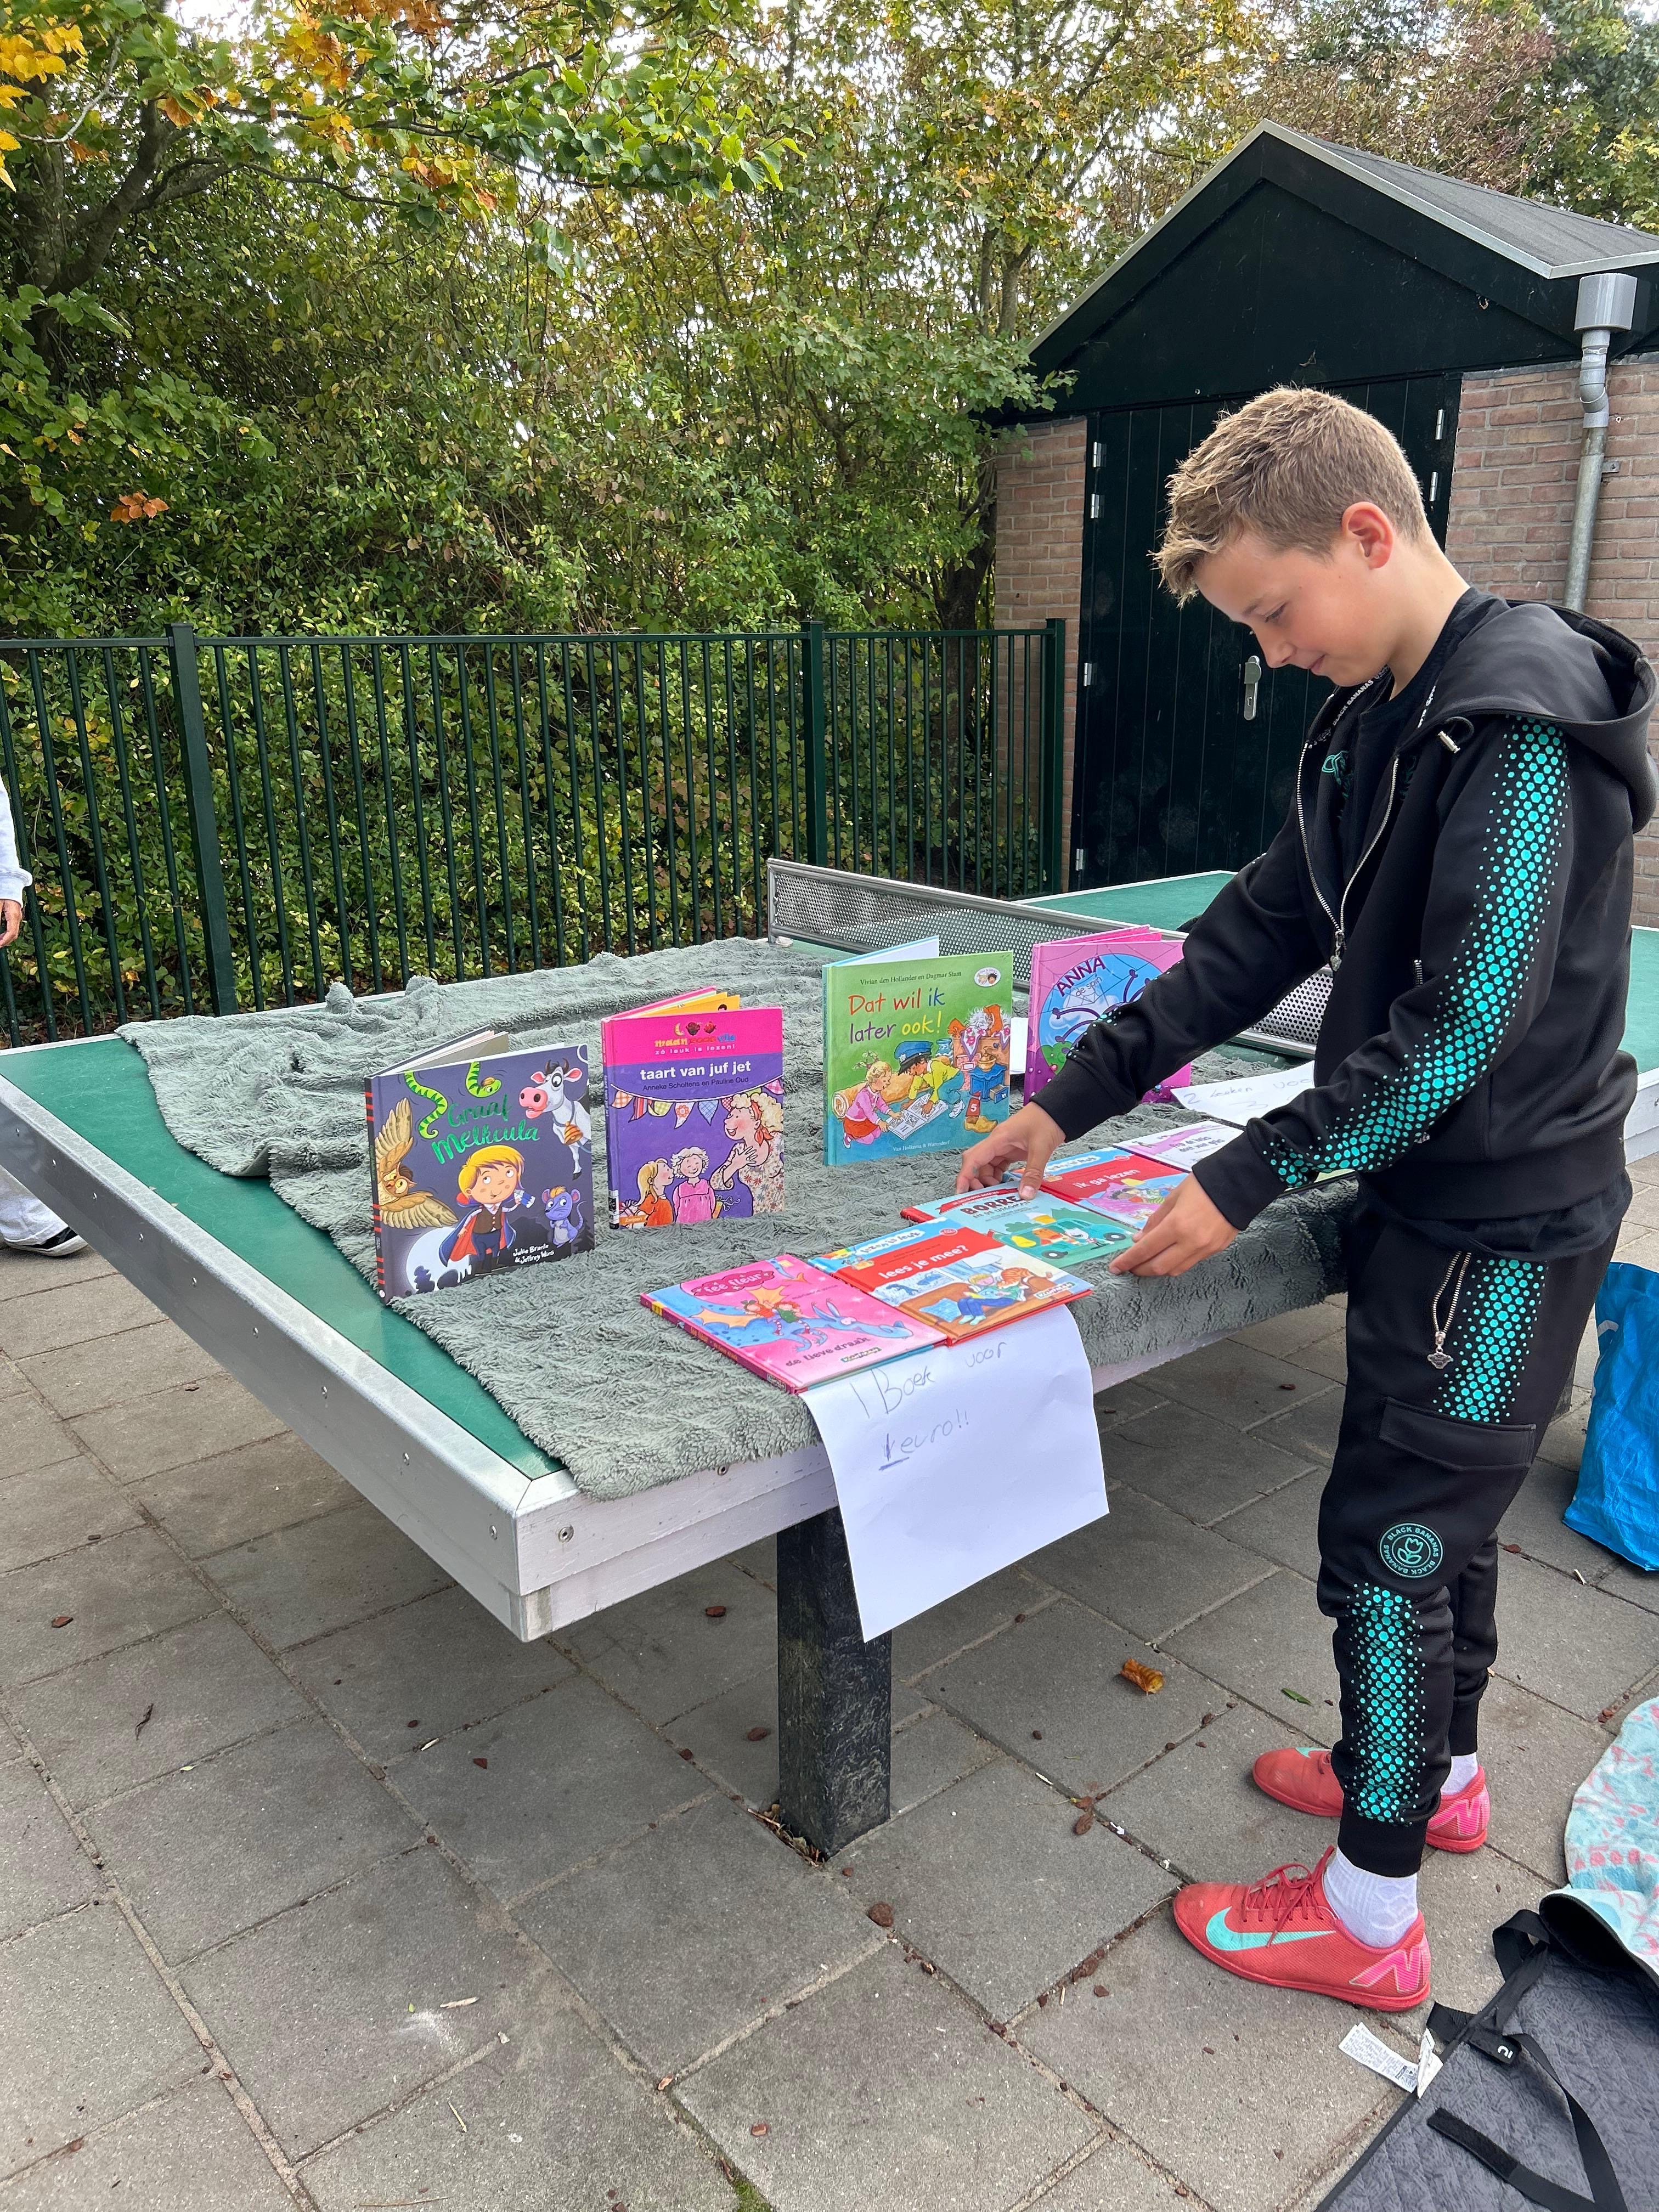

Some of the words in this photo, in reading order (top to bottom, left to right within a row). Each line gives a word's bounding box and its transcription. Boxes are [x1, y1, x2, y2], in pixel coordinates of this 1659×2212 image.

[1347, 680, 1374, 705] BANANAS
[890, 974, 917, 983] Hollander
[926, 972, 947, 981] Dagmar
[1057, 956, 1107, 997] ANNA
[848, 992, 886, 1015] Dat
[893, 987, 921, 1011] wil
[928, 987, 946, 1007] ik
[1076, 987, 1086, 997] de
[850, 1021, 897, 1044] later
[901, 1010, 942, 1036] ook!
[654, 1037, 688, 1048] maan
[640, 1066, 676, 1080] taart
[680, 1066, 705, 1077] van
[709, 1062, 729, 1077] juf
[732, 1060, 751, 1075] jet
[1184, 1093, 1202, 1104] 2
[1272, 1078, 1312, 1090] voo
[448, 1093, 513, 1127] Graaf
[970, 1103, 978, 1112] 5
[431, 1119, 540, 1164] Melkcula
[1089, 1177, 1108, 1186] ga
[1103, 1169, 1141, 1180] lezen
[959, 1195, 1024, 1215] BORRE
[899, 1231, 921, 1240] leuk
[878, 1265, 913, 1279] lees
[910, 1260, 930, 1270] je
[929, 1244, 969, 1262] mee?
[704, 1283, 729, 1293] fee
[728, 1271, 762, 1288] fleur
[786, 1358, 802, 1367] de
[803, 1348, 834, 1361] lieve
[834, 1336, 871, 1351] draak
[871, 1365, 935, 1415] Boek
[964, 1342, 1008, 1368] voor
[1387, 1526, 1413, 1541] BLACK
[1414, 1527, 1439, 1557] BANANAS
[1384, 1544, 1408, 1573] BANANAS
[1411, 1560, 1436, 1575] BLACK
